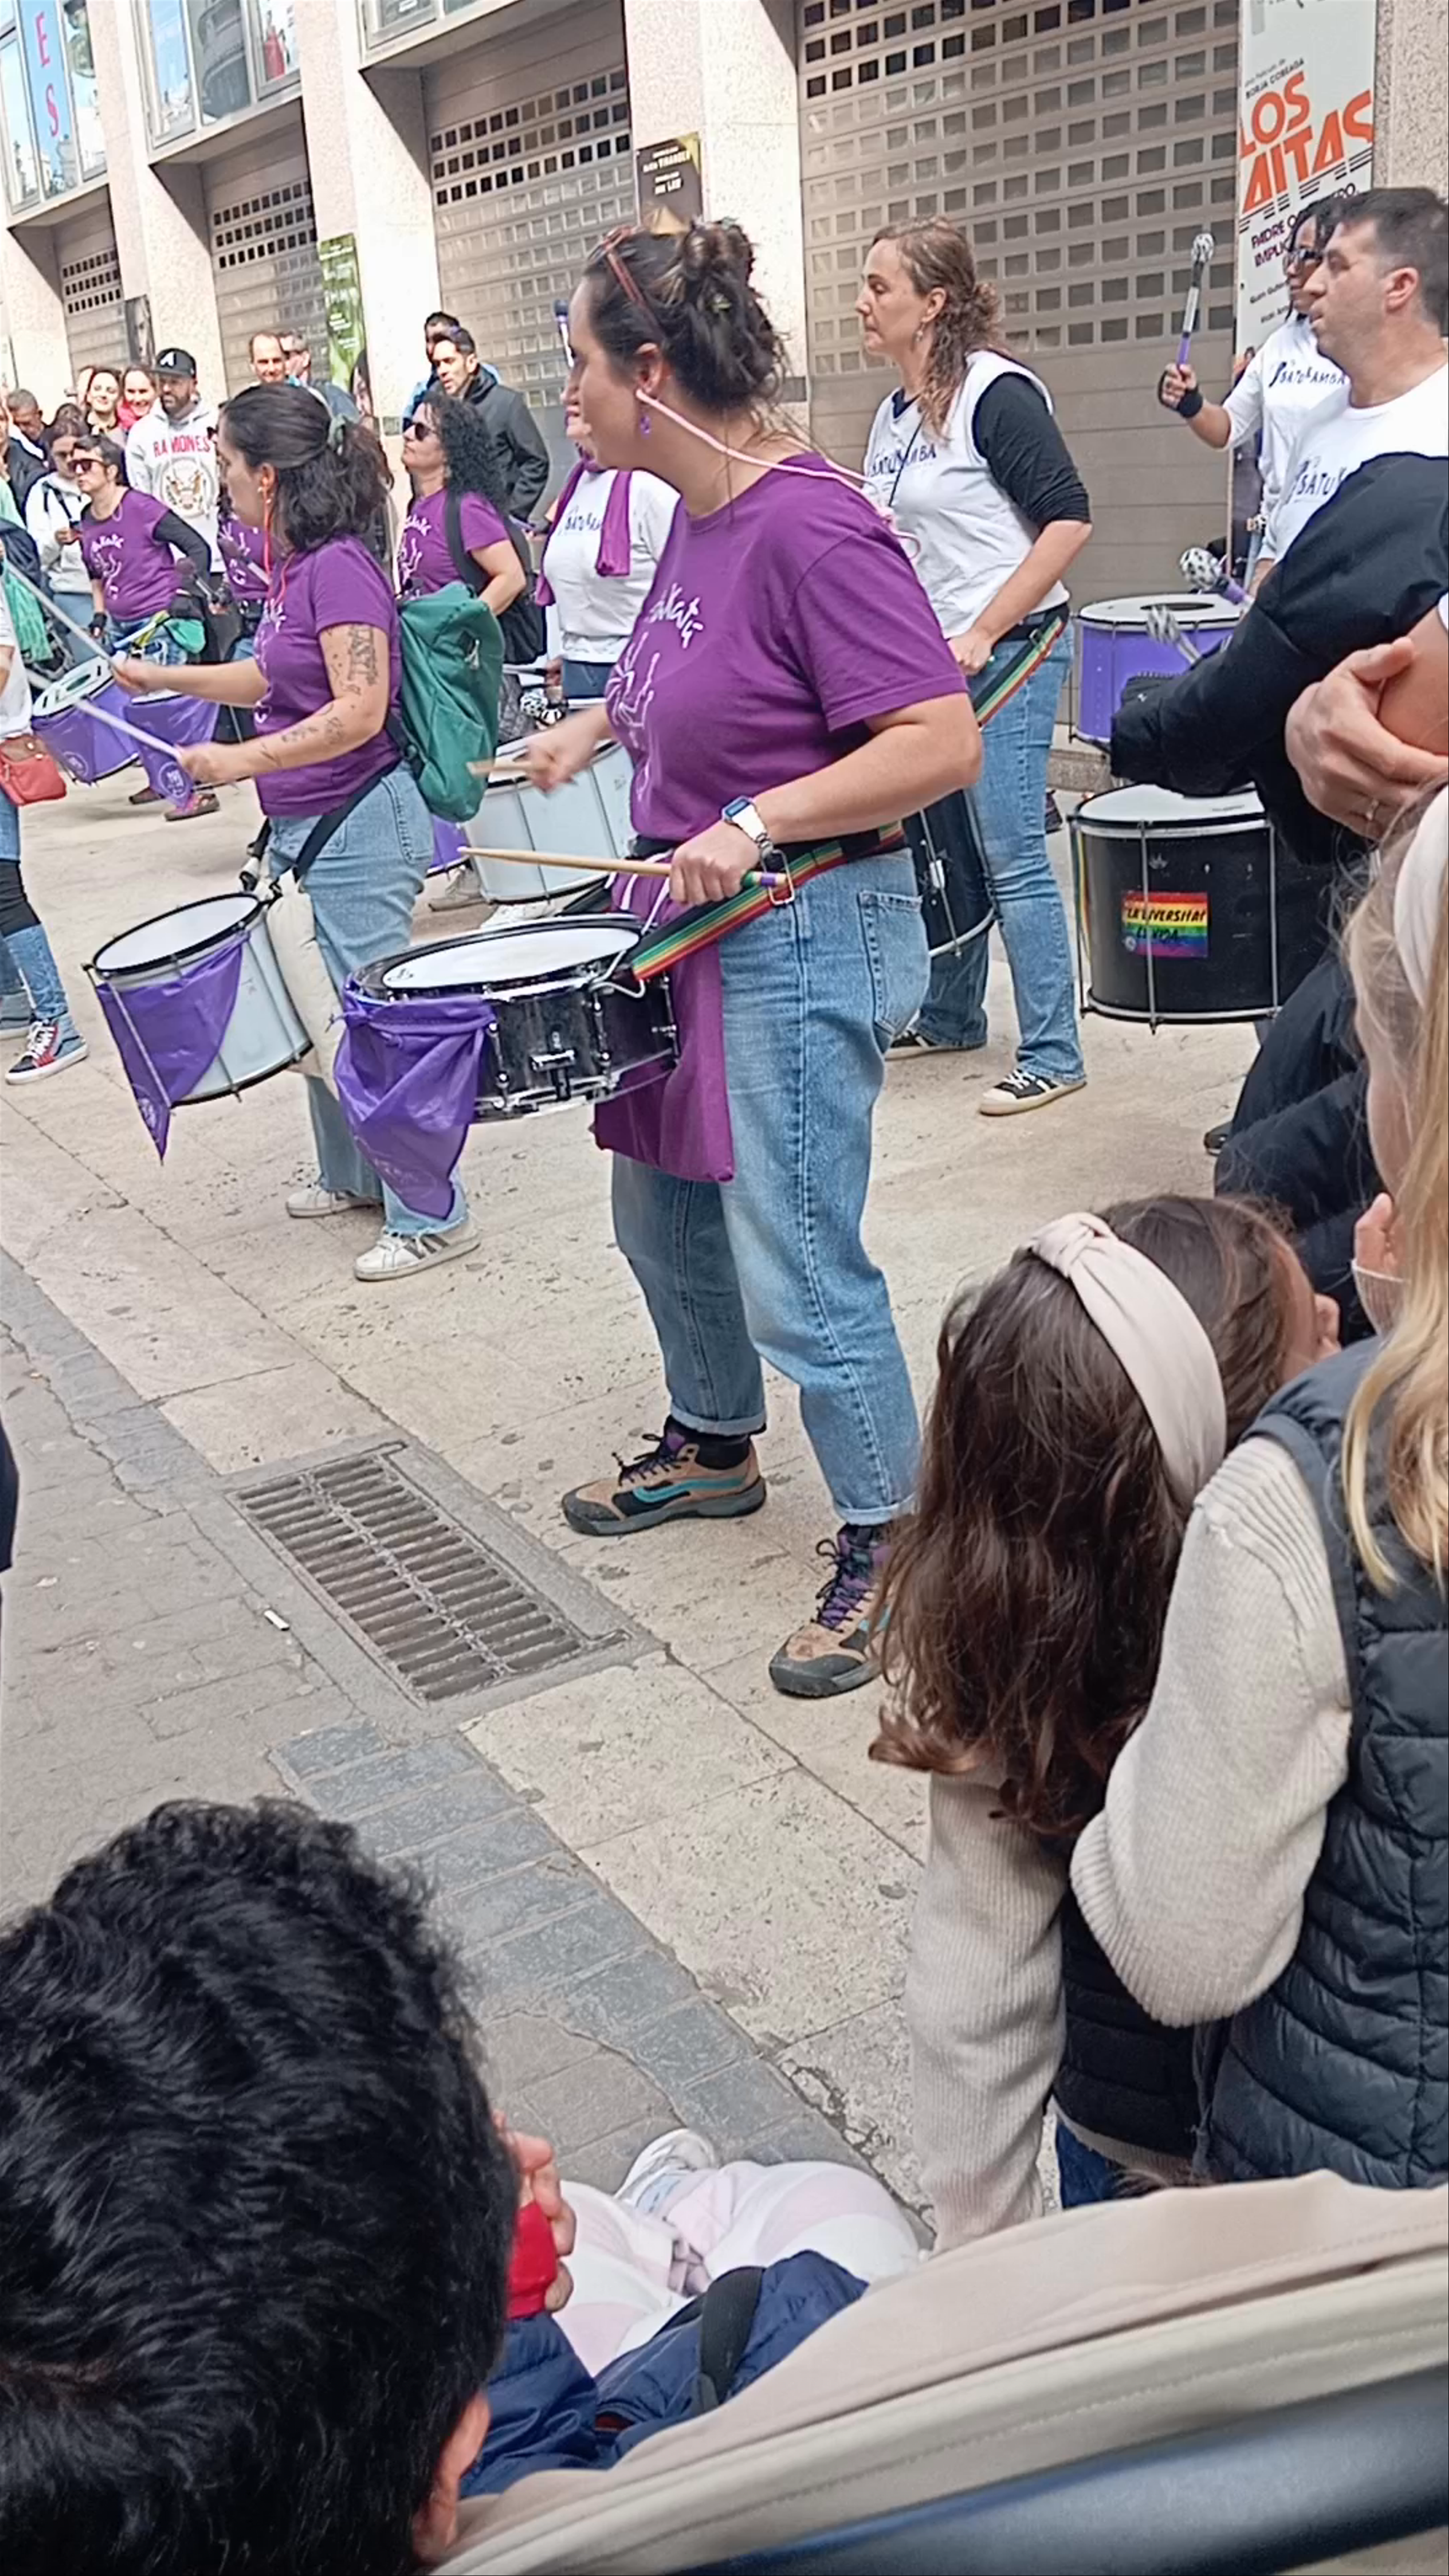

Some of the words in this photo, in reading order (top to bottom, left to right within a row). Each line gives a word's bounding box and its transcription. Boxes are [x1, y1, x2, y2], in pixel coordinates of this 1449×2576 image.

[1239, 71, 1310, 159] LOS
[1241, 89, 1374, 214] AITAS
[1251, 220, 1284, 249] PADRE
[153, 434, 211, 458] RAMONES
